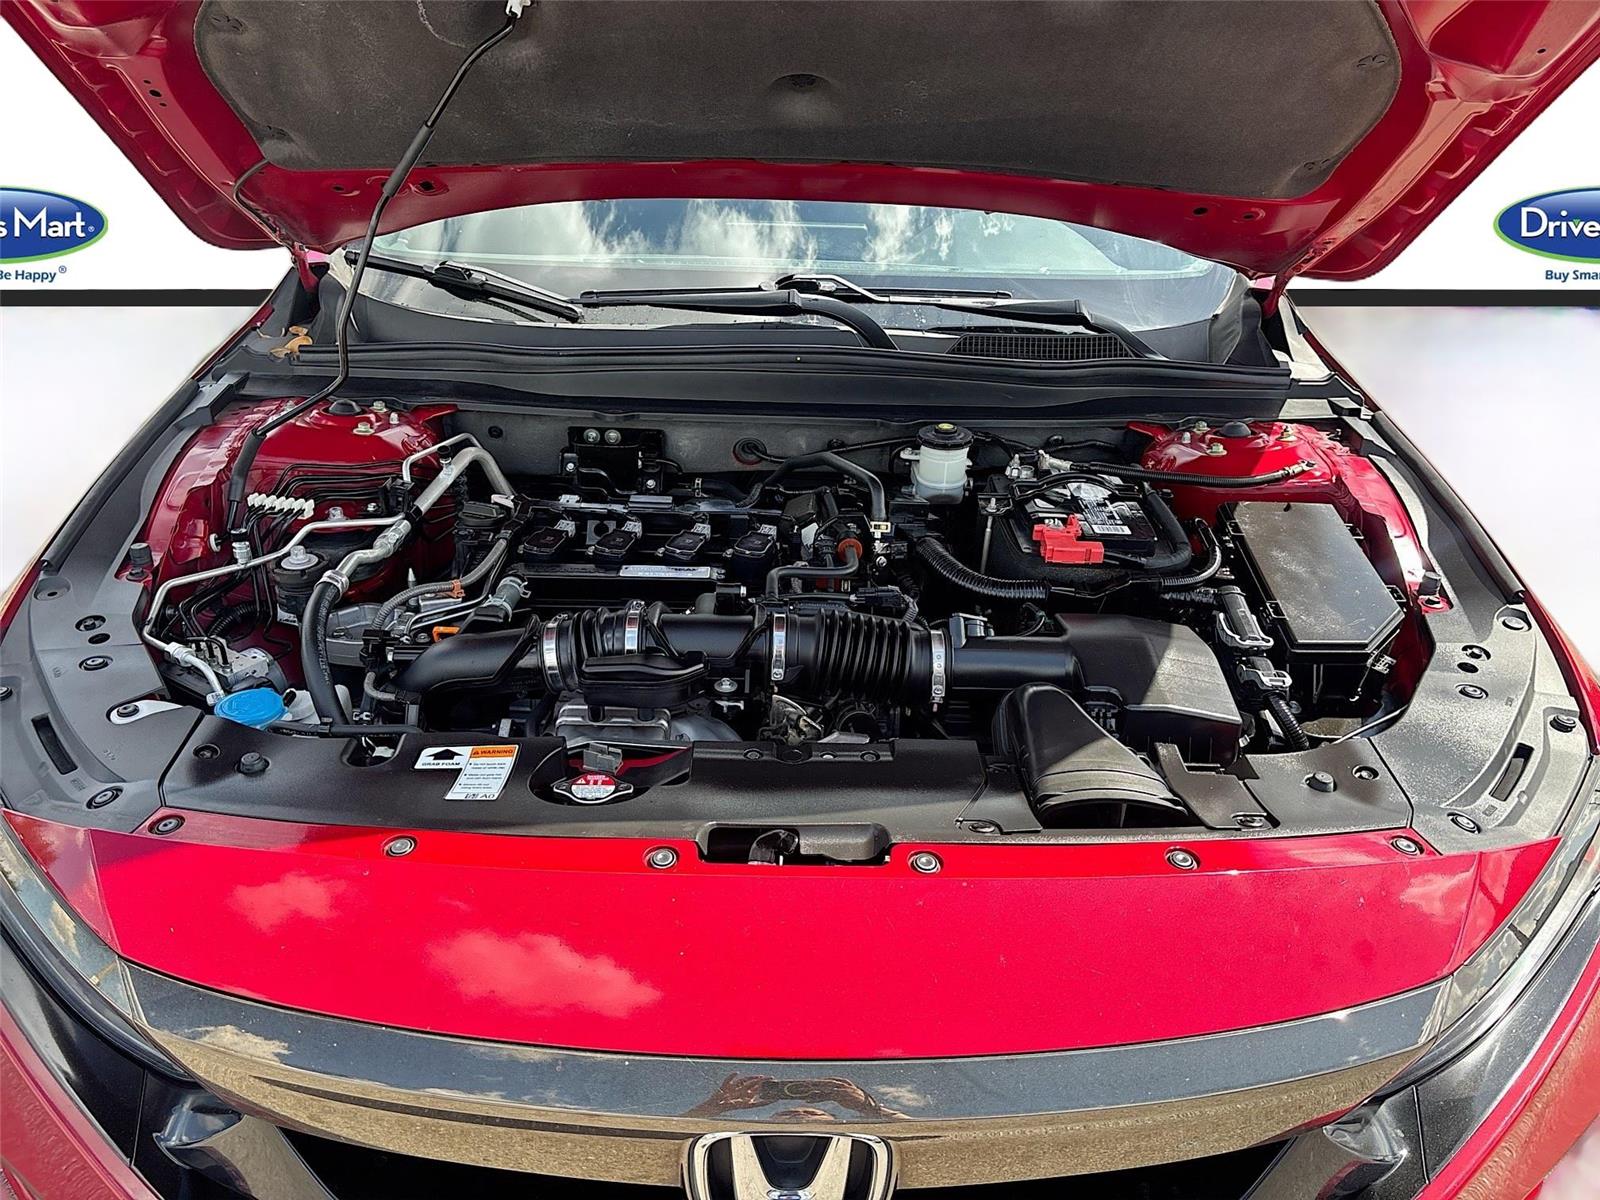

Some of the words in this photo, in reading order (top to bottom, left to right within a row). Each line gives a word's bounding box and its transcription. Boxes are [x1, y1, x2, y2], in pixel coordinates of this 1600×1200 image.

[14, 207, 86, 237] Mart
[1521, 207, 1600, 237] Drive
[15, 270, 57, 283] Happy
[1545, 269, 1570, 283] Buy
